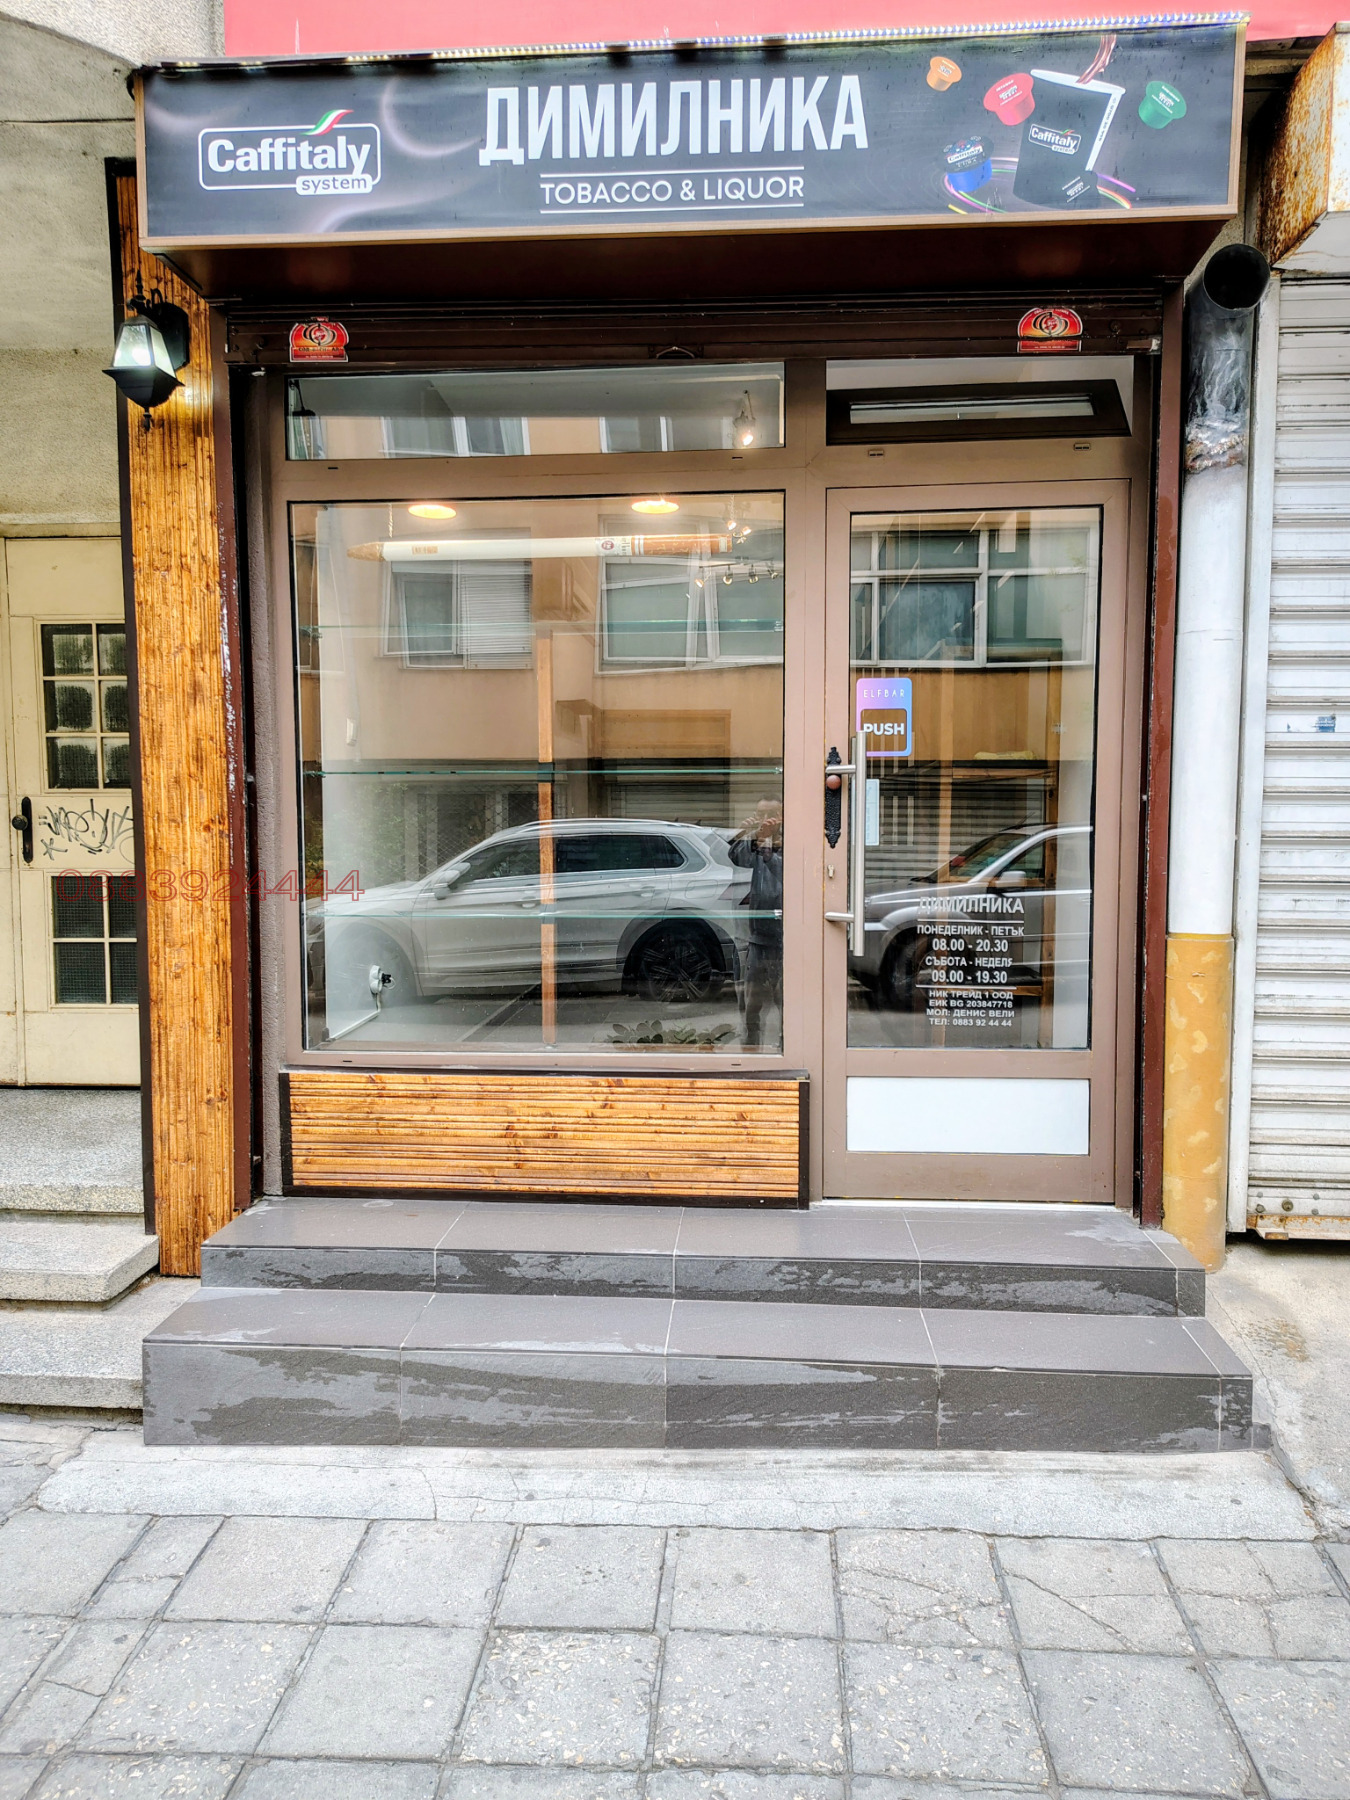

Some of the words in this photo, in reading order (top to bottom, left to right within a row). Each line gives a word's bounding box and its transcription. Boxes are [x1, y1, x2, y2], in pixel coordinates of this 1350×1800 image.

[479, 74, 868, 166] ДИМИЛНИКА
[1031, 128, 1078, 149] Caffitaly
[208, 135, 371, 175] Caffitaly
[301, 176, 367, 193] system
[540, 180, 673, 205] TOBACCO
[681, 178, 697, 201] &
[704, 176, 804, 202] LIQUOR
[863, 689, 905, 698] ELFBAR
[863, 723, 905, 735] PUSH
[918, 897, 1025, 914] ДИМИЛНИКА
[917, 925, 983, 936] ПОНЕДЕЛНИК
[991, 926, 1024, 936] ПЕТЪК
[932, 939, 965, 951] 08.00
[976, 940, 1008, 952] 20.30
[925, 957, 967, 967] СЪБОТА
[975, 957, 1013, 968] НЕДЕЛЯ
[932, 970, 964, 983] 09.00
[976, 971, 1008, 983] 19.30
[929, 990, 949, 998] НИК
[951, 990, 982, 1000] ТРЕЙД
[992, 992, 1013, 1000] ООД
[929, 999, 948, 1007] ЕИК
[966, 1000, 1013, 1008] 203847718
[926, 1008, 951, 1016] МОЛ:
[953, 1009, 986, 1017] ДЕНИС
[929, 1018, 950, 1026] ТЕЛ:
[952, 1018, 973, 1026] 0883
